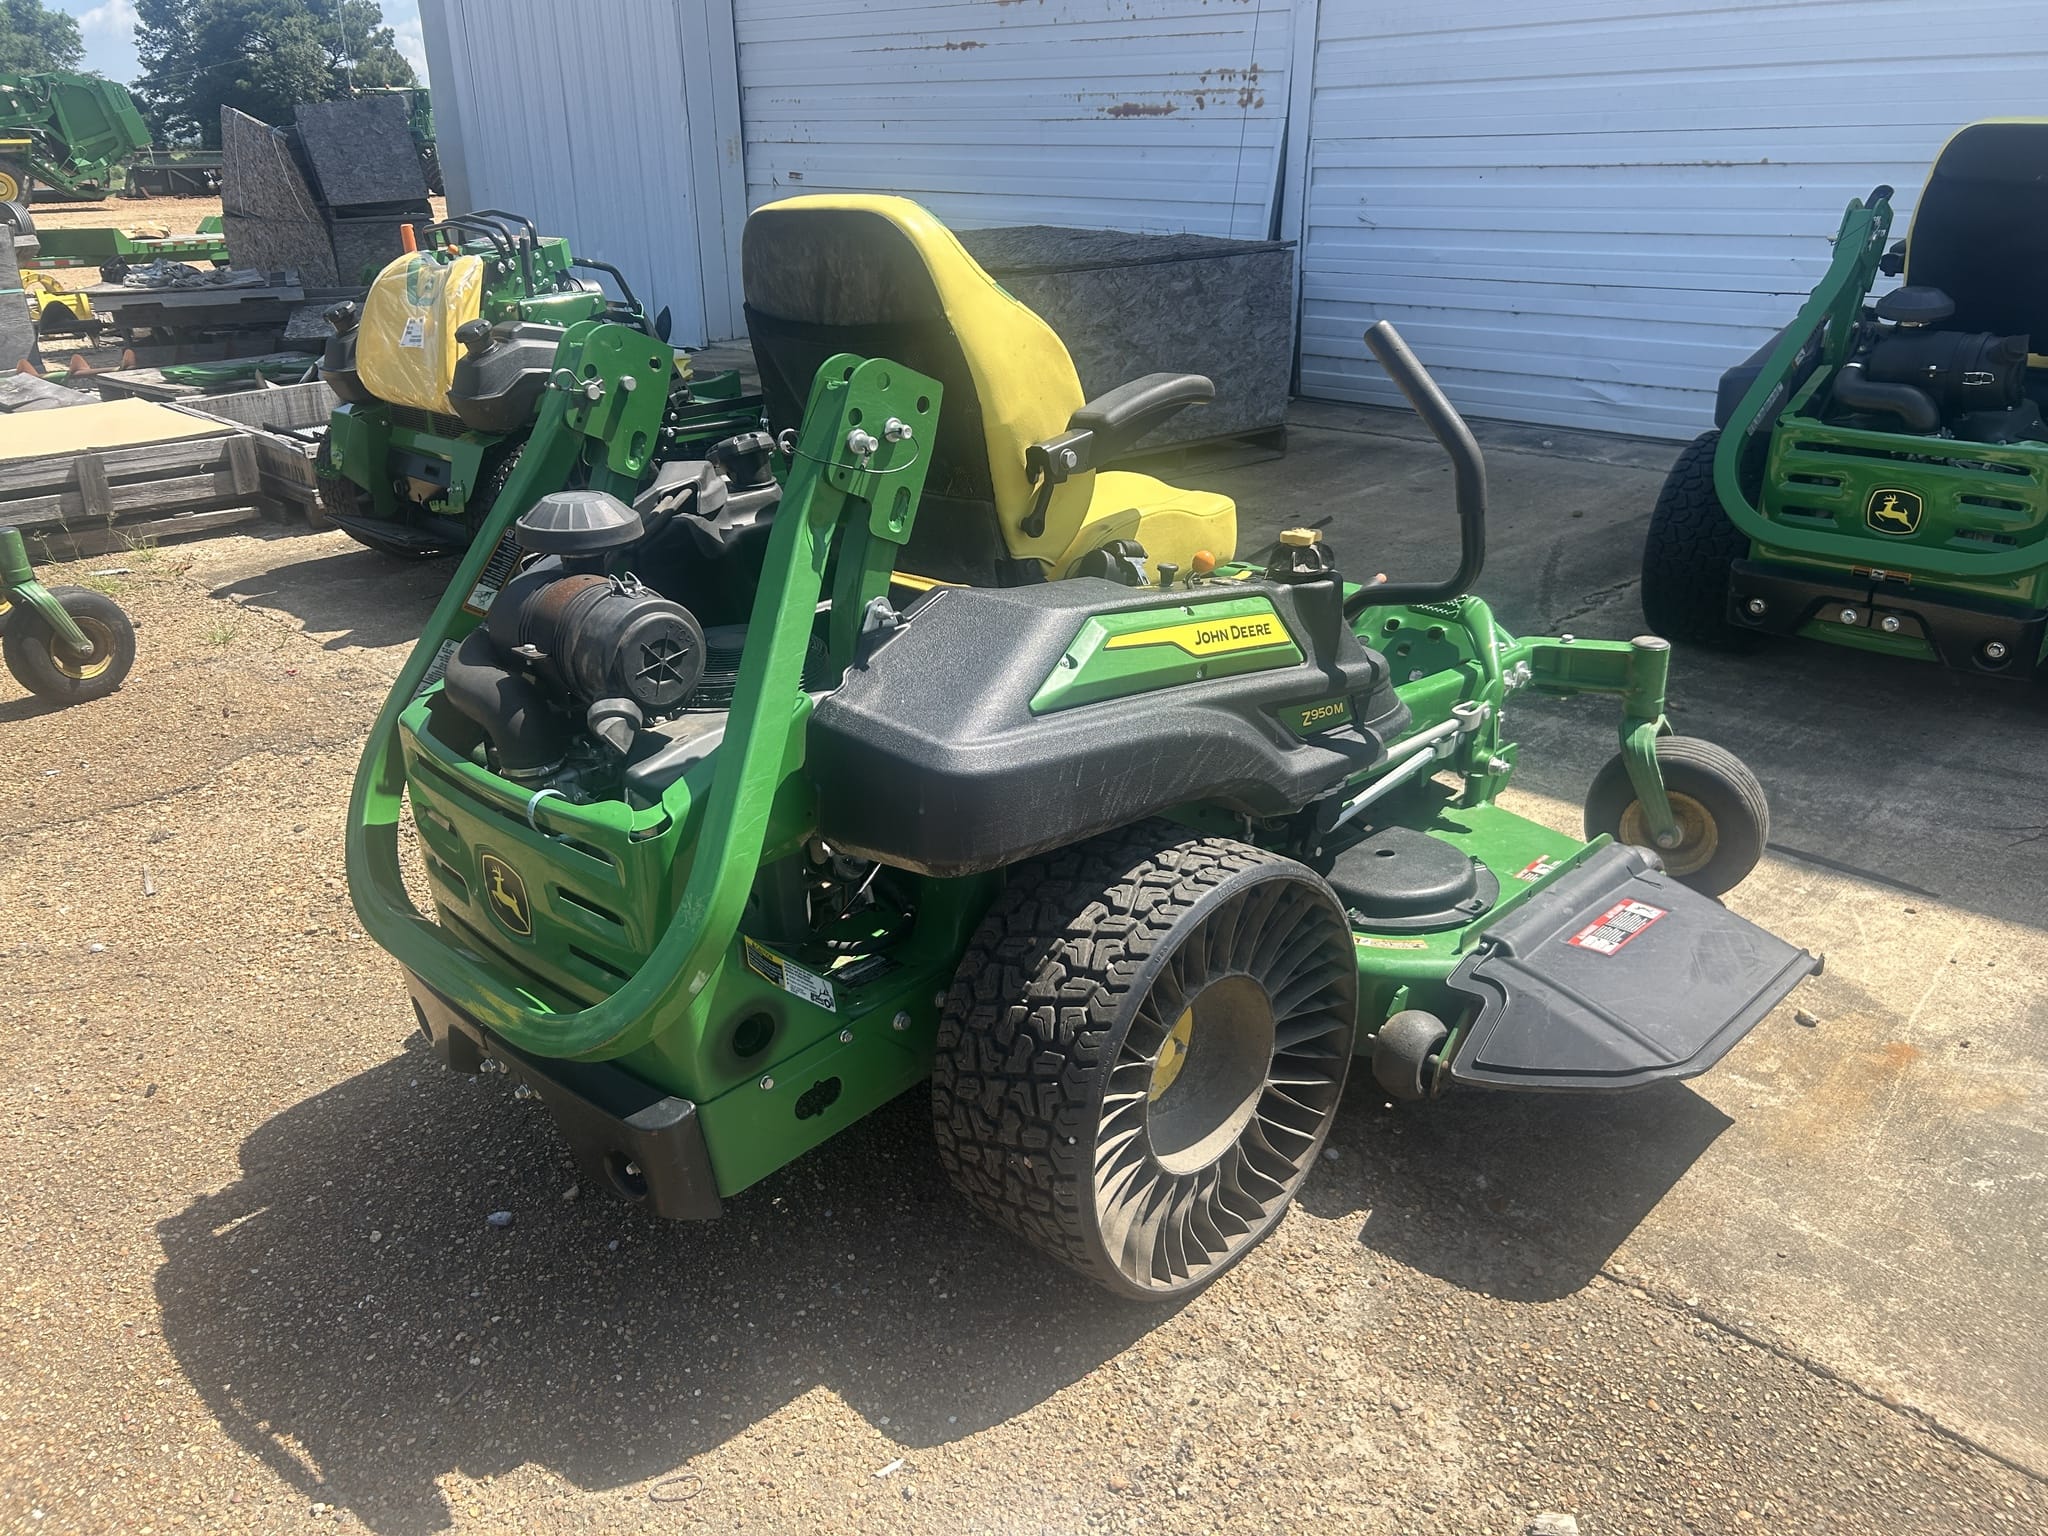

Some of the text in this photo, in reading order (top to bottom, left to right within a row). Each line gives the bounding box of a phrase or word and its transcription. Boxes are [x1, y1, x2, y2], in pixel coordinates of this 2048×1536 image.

[1195, 623, 1272, 646] JOHN DEERE
[1301, 702, 1344, 727] Z950M
